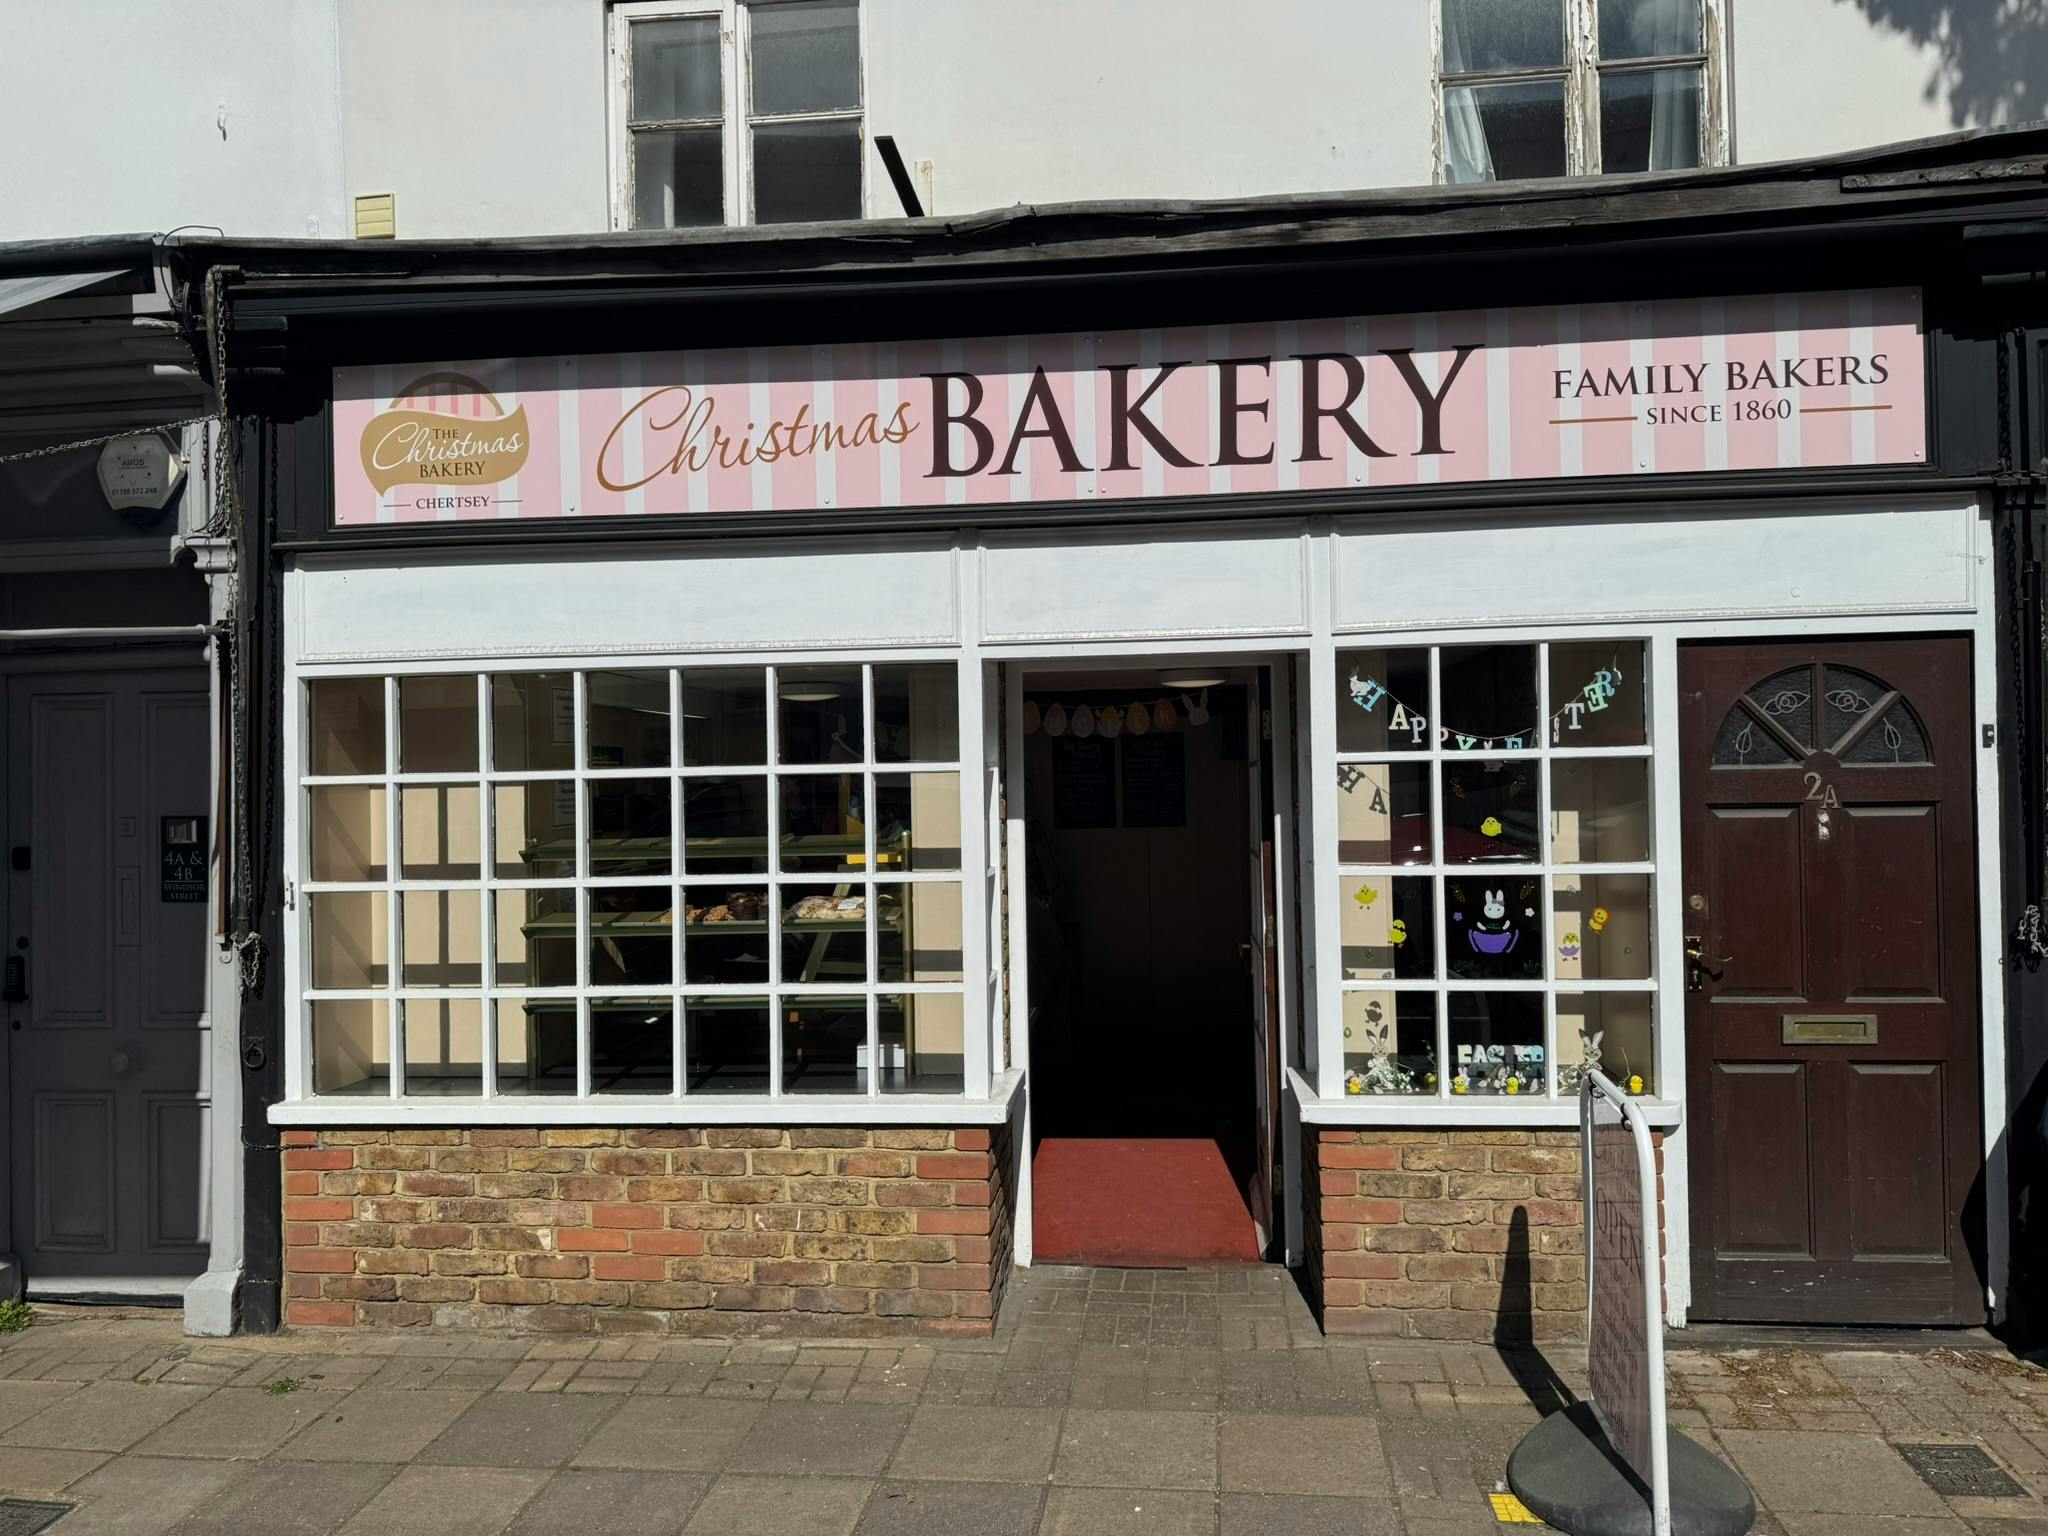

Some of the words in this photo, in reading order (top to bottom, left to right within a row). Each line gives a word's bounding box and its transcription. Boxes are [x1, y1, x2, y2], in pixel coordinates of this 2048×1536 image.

[1552, 362, 1709, 400] FAMILY
[1725, 354, 1890, 391] BAKERS
[596, 384, 920, 493] Christmas
[921, 343, 1484, 477] BAKERY
[1646, 404, 1723, 425] SINCE
[1731, 398, 1792, 421] 1860
[432, 427, 459, 440] THE
[372, 421, 523, 470] Christmas
[418, 460, 486, 479] BAKERY
[415, 495, 490, 510] CHERTSEY
[1804, 771, 1842, 808] 2A
[164, 851, 185, 865] 4A
[190, 850, 203, 865] &
[174, 866, 193, 880] 4B
[163, 883, 206, 892] WINDSOR
[169, 892, 200, 900] STREET
[1596, 1187, 1642, 1284] OPEN
[1609, 1398, 1631, 1442] Coffee
